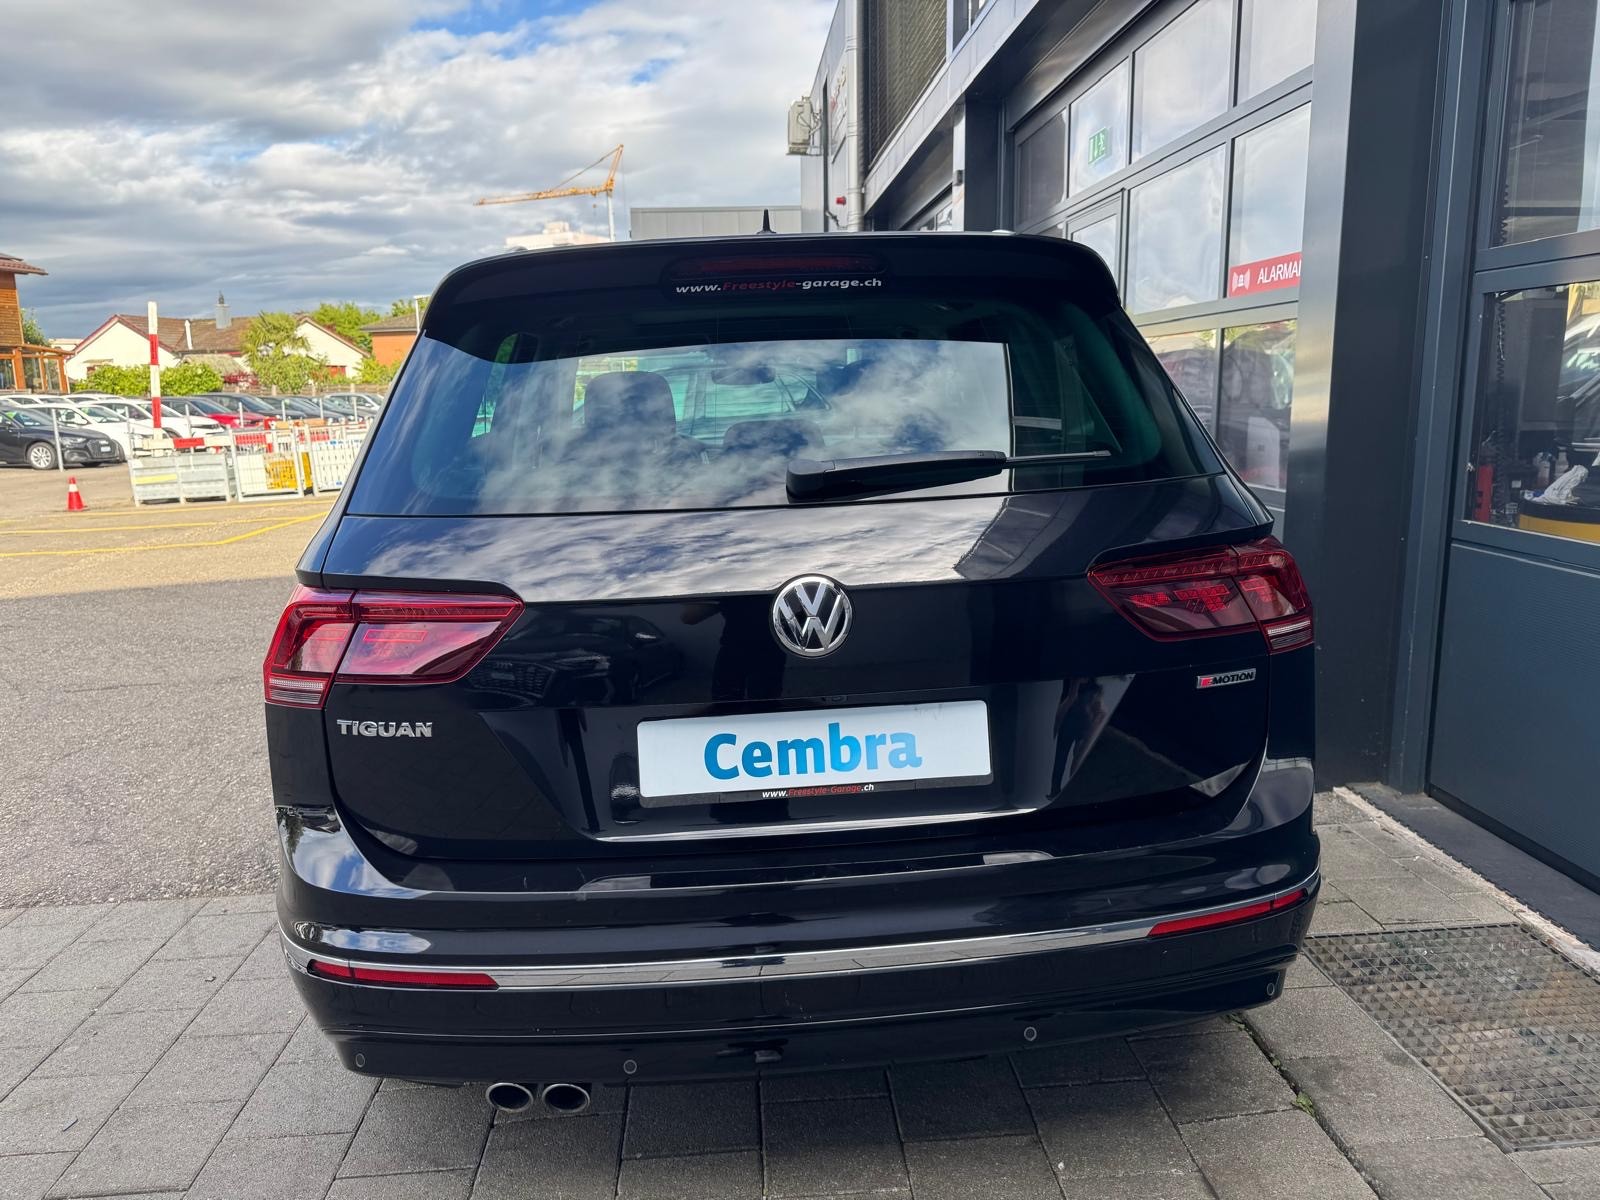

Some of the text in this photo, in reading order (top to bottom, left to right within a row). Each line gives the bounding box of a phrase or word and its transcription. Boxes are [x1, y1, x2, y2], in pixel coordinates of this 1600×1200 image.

[676, 278, 882, 293] www.Freestyle-garage.ch
[777, 579, 847, 653] VW
[336, 719, 433, 738] TIGUAN
[704, 722, 922, 780] Cembra
[762, 783, 875, 798] www.Freestyle-Garage.ch
